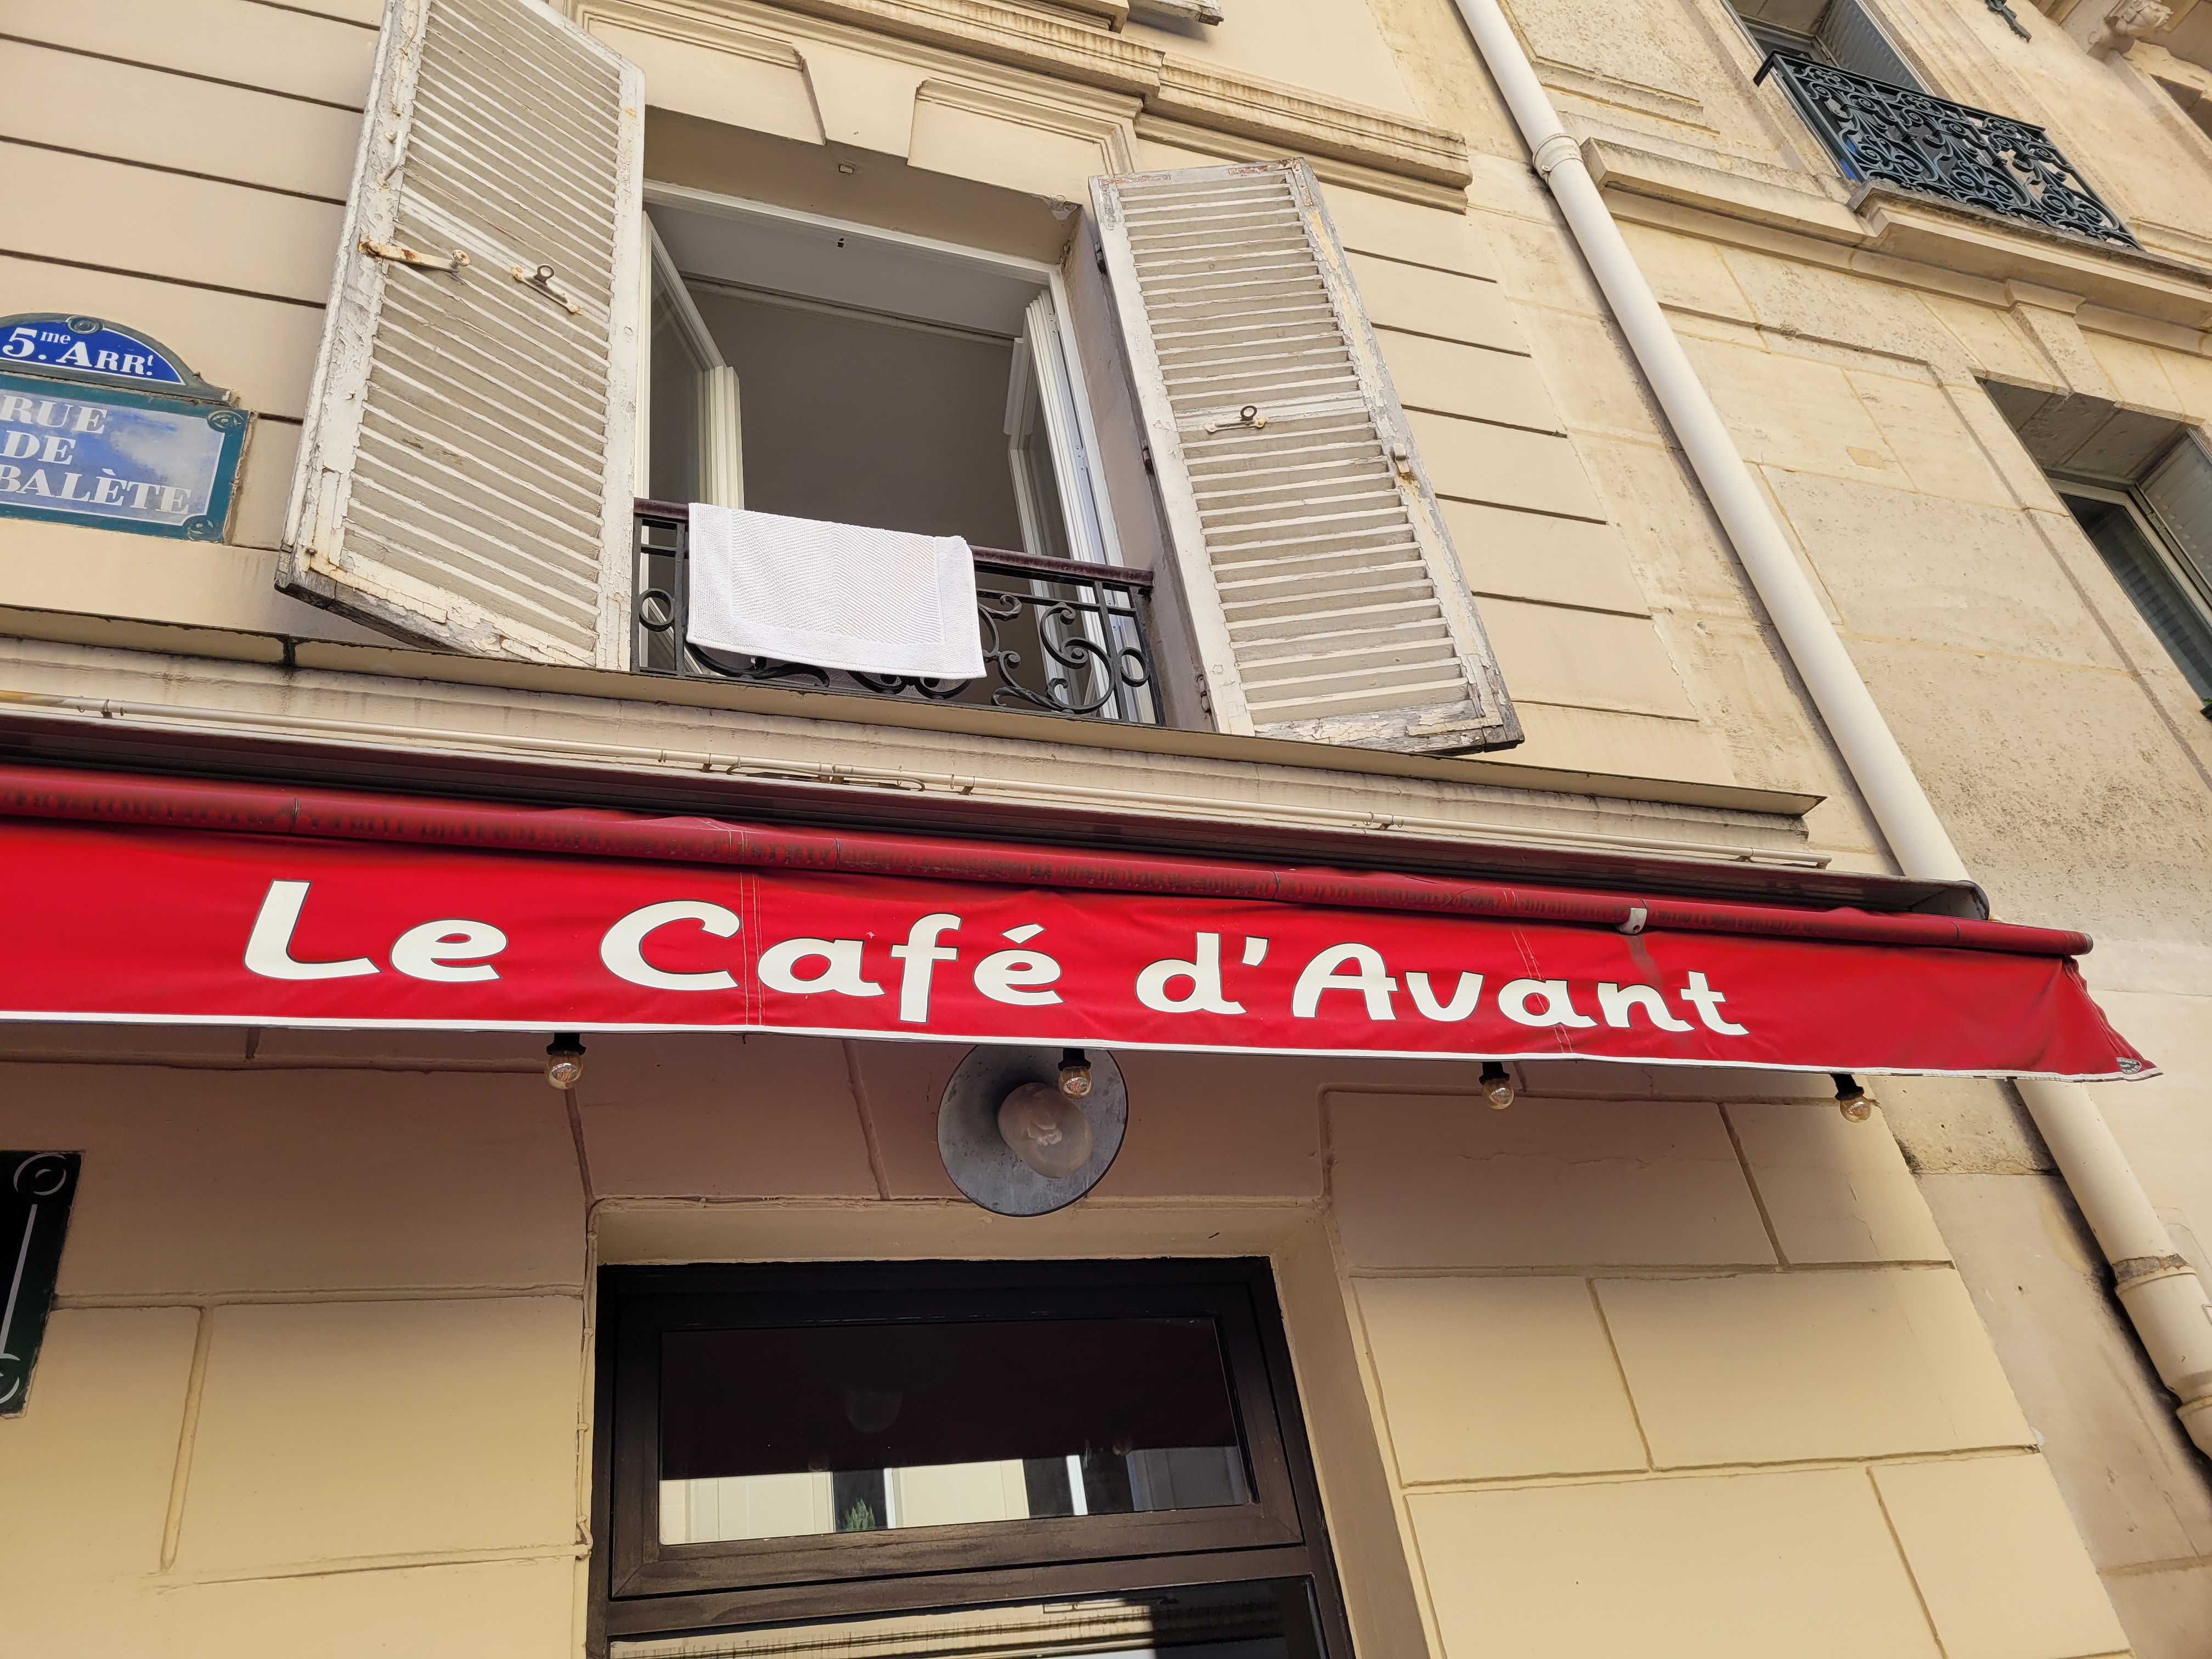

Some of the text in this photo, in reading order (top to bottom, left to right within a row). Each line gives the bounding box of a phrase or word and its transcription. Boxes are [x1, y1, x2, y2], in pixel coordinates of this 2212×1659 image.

[0, 394, 108, 435] RUE
[0, 430, 77, 465] DE
[244, 879, 1751, 1036] Le Café d'Avant
